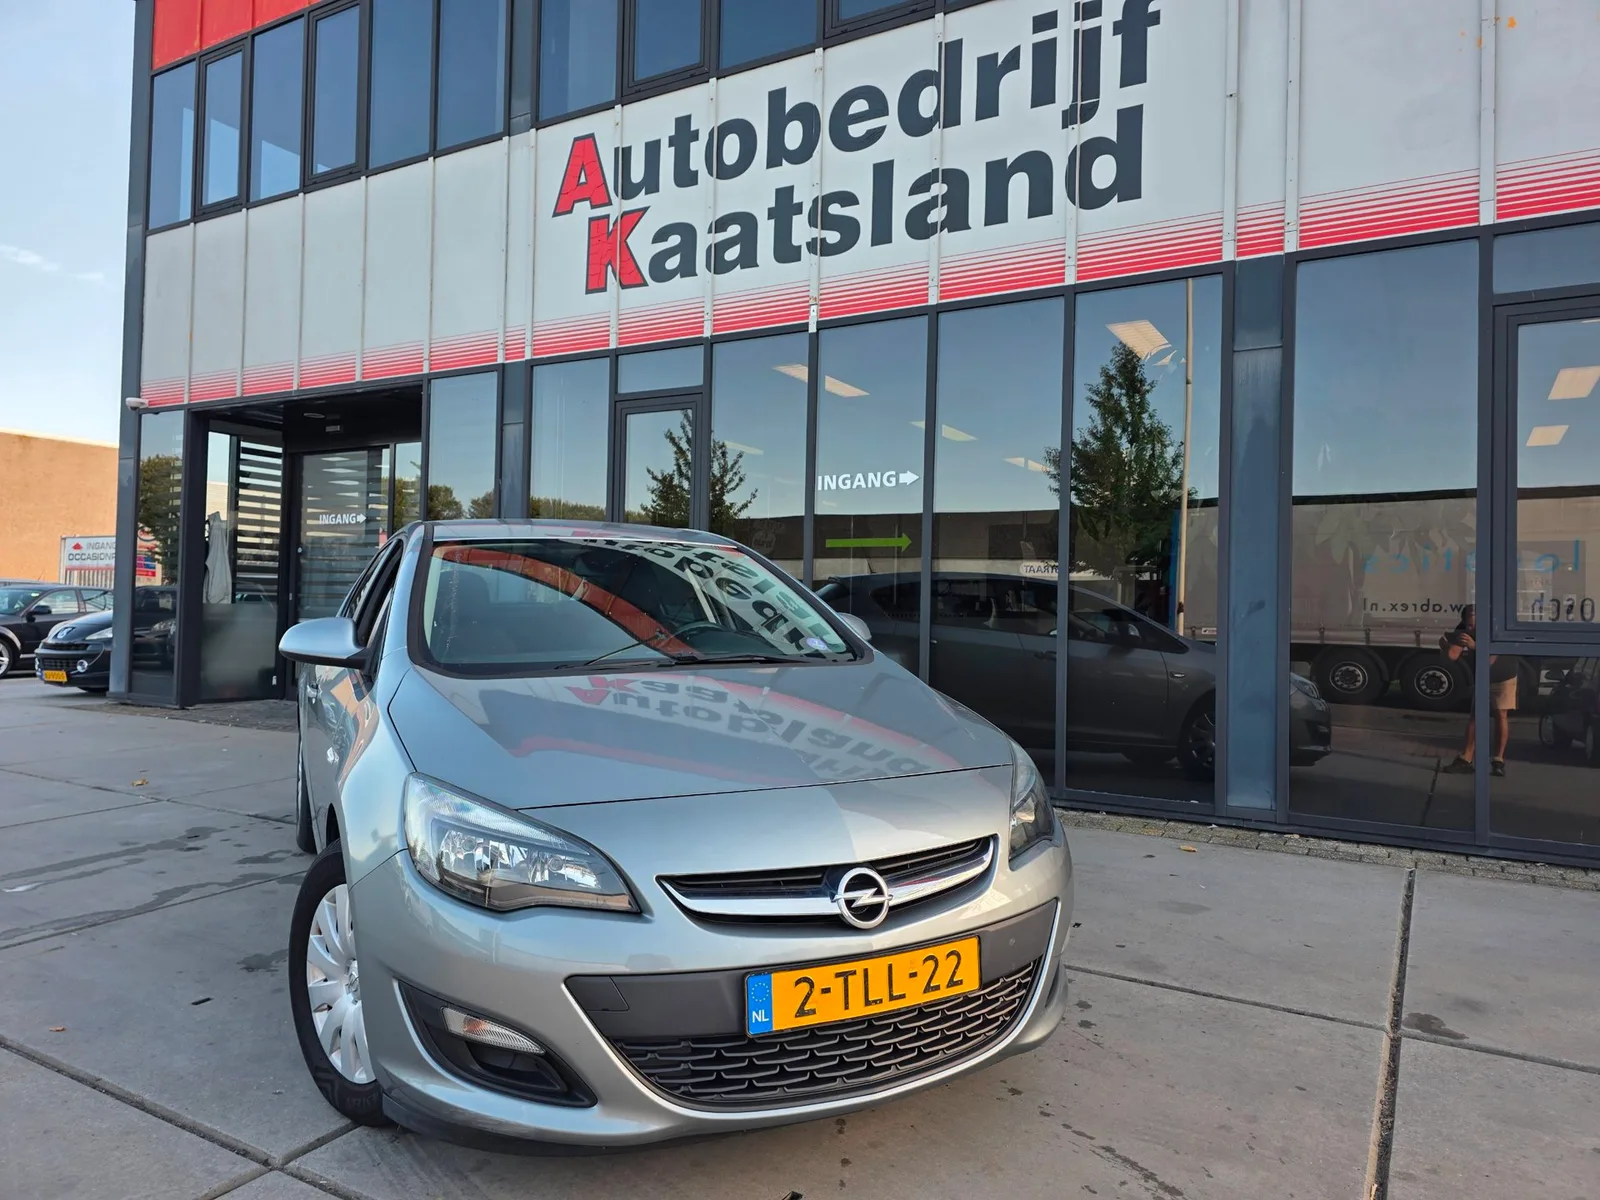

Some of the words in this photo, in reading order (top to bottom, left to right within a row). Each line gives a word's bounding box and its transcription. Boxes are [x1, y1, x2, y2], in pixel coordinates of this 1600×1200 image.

[552, 0, 1161, 217] Autobedrijf
[586, 103, 1144, 295] Kaatsland
[817, 470, 897, 491] INGANG
[319, 513, 358, 525] INGANG
[794, 949, 964, 1018] 2-TLL-22
[752, 1009, 770, 1023] NL
